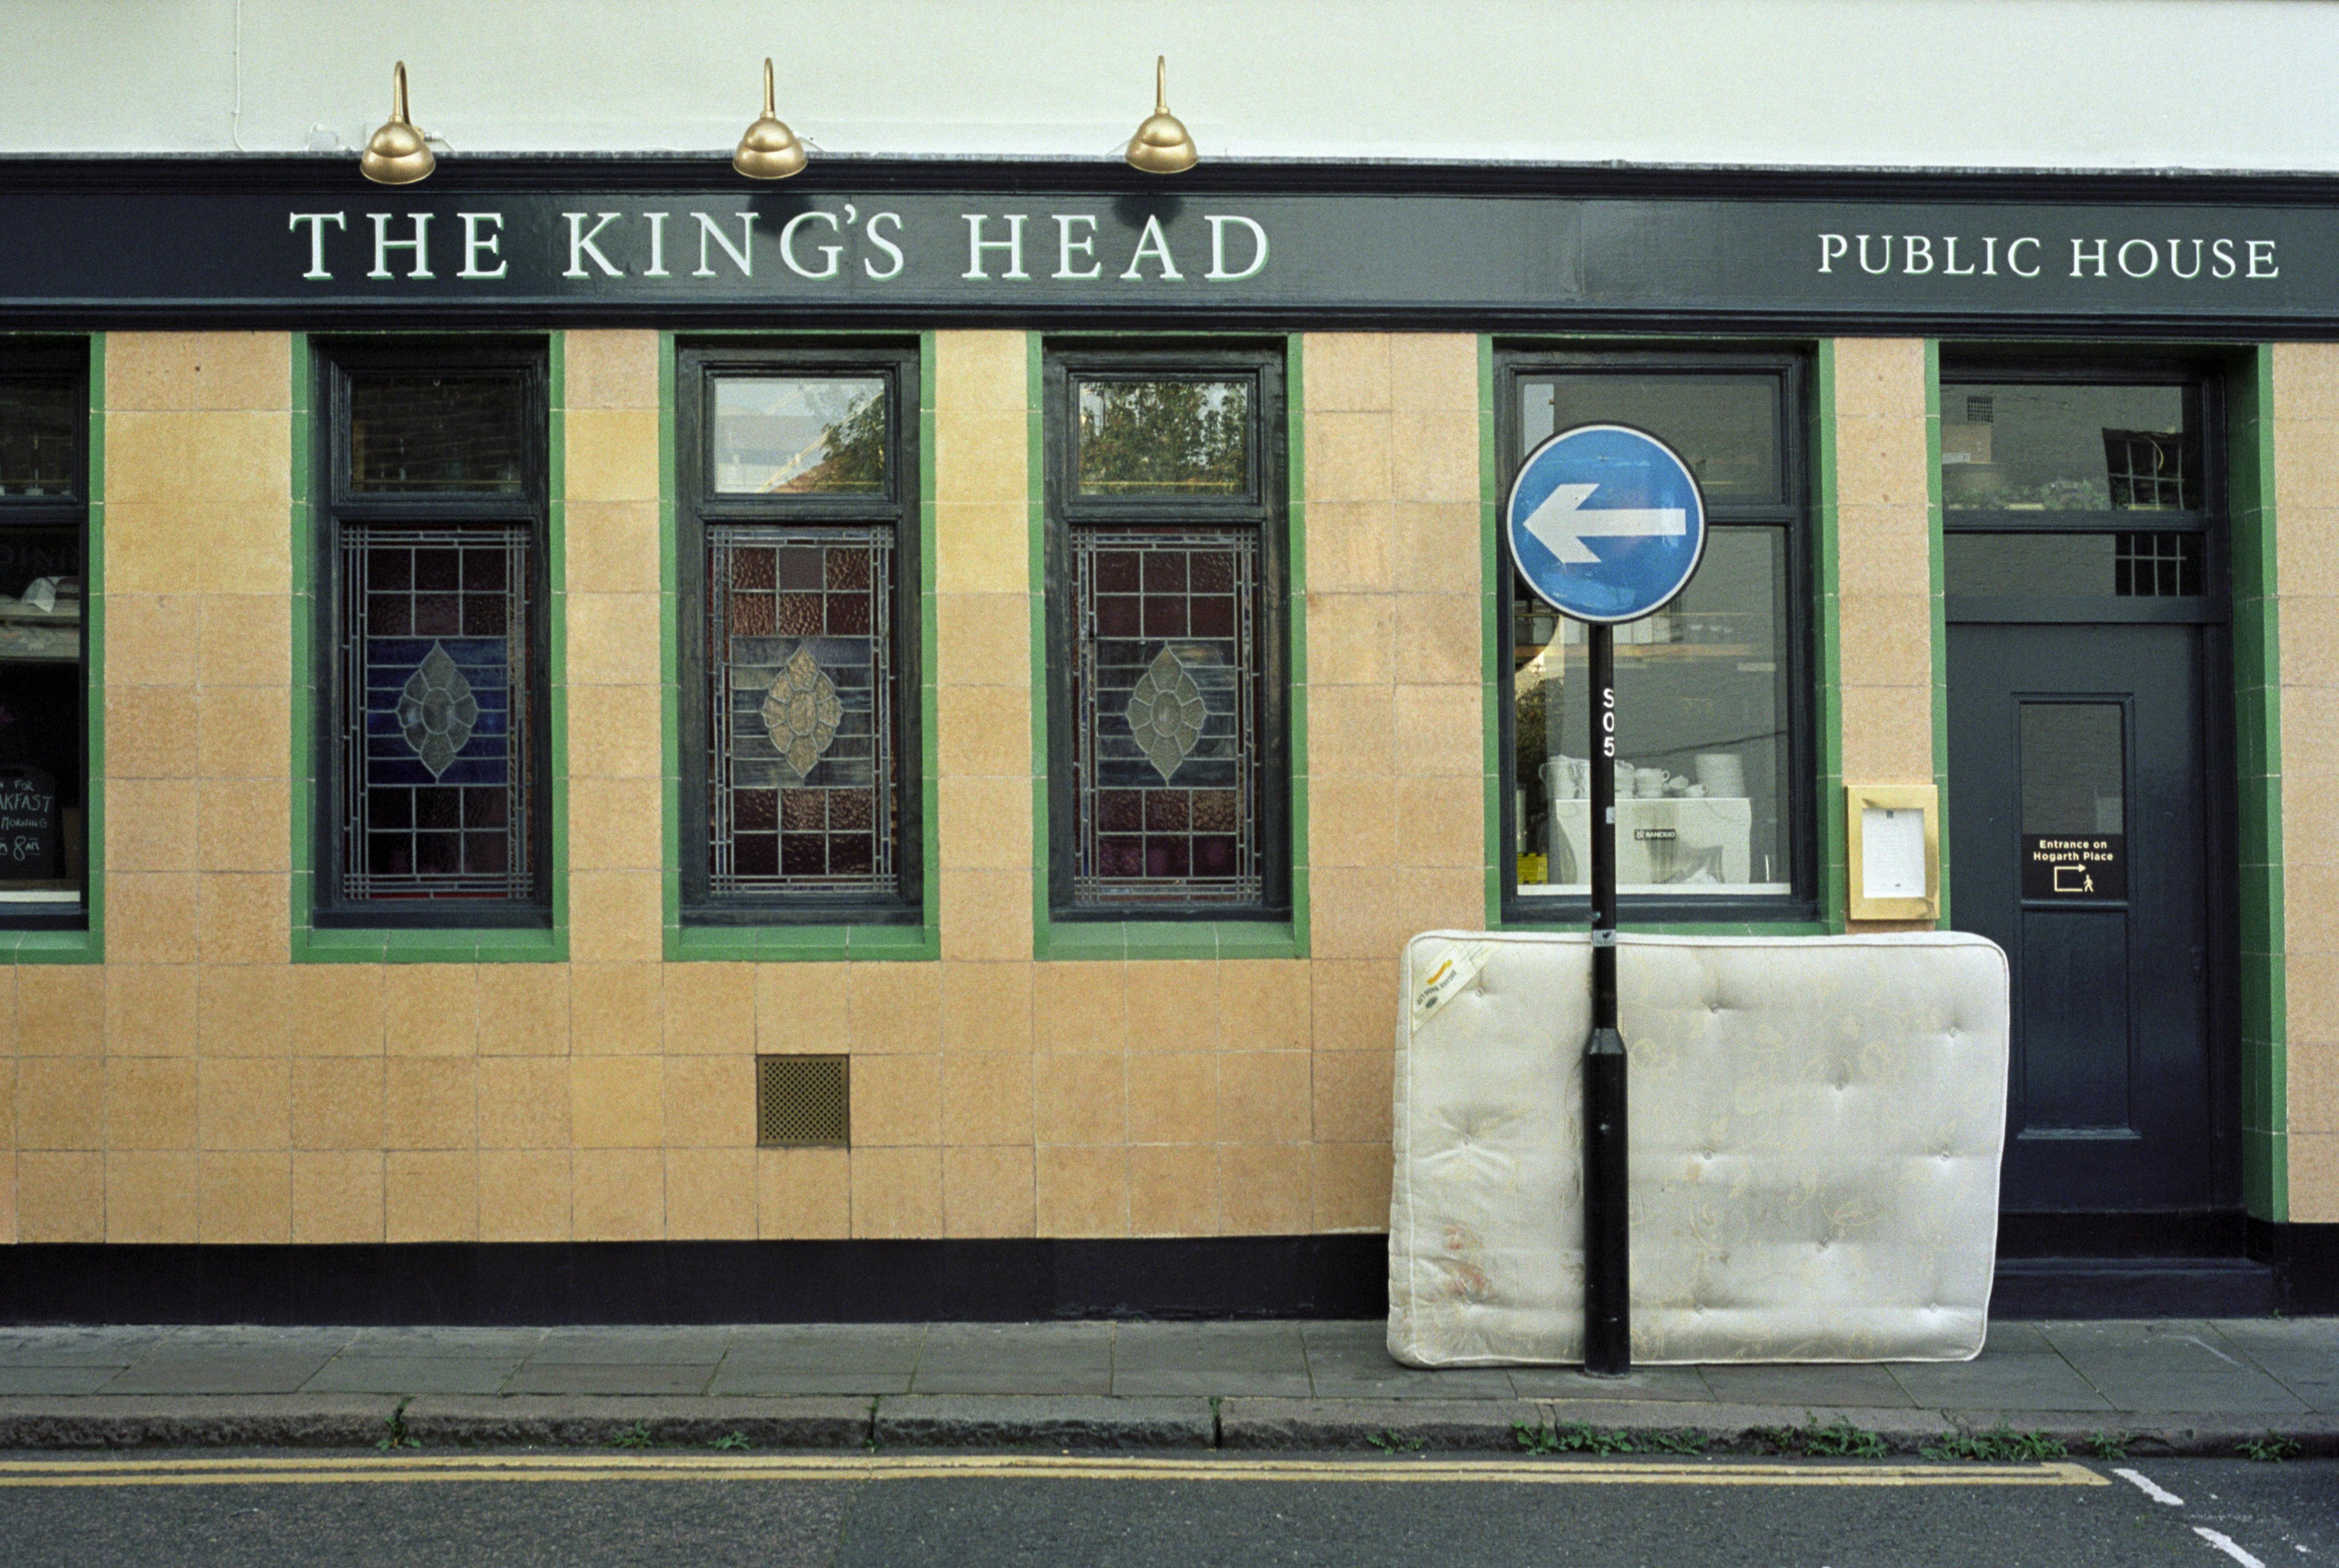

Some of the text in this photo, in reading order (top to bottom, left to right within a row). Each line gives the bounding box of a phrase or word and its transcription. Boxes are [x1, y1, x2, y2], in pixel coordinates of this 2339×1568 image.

[289, 203, 1270, 282] THE KING'S HEAD
[1818, 234, 2279, 279] PUBLIC HOUSE
[14, 779, 34, 791] FOR
[1, 816, 47, 830] MORNING
[2039, 839, 2108, 849] Entrance on
[2033, 852, 2113, 863] Hogarth Place
